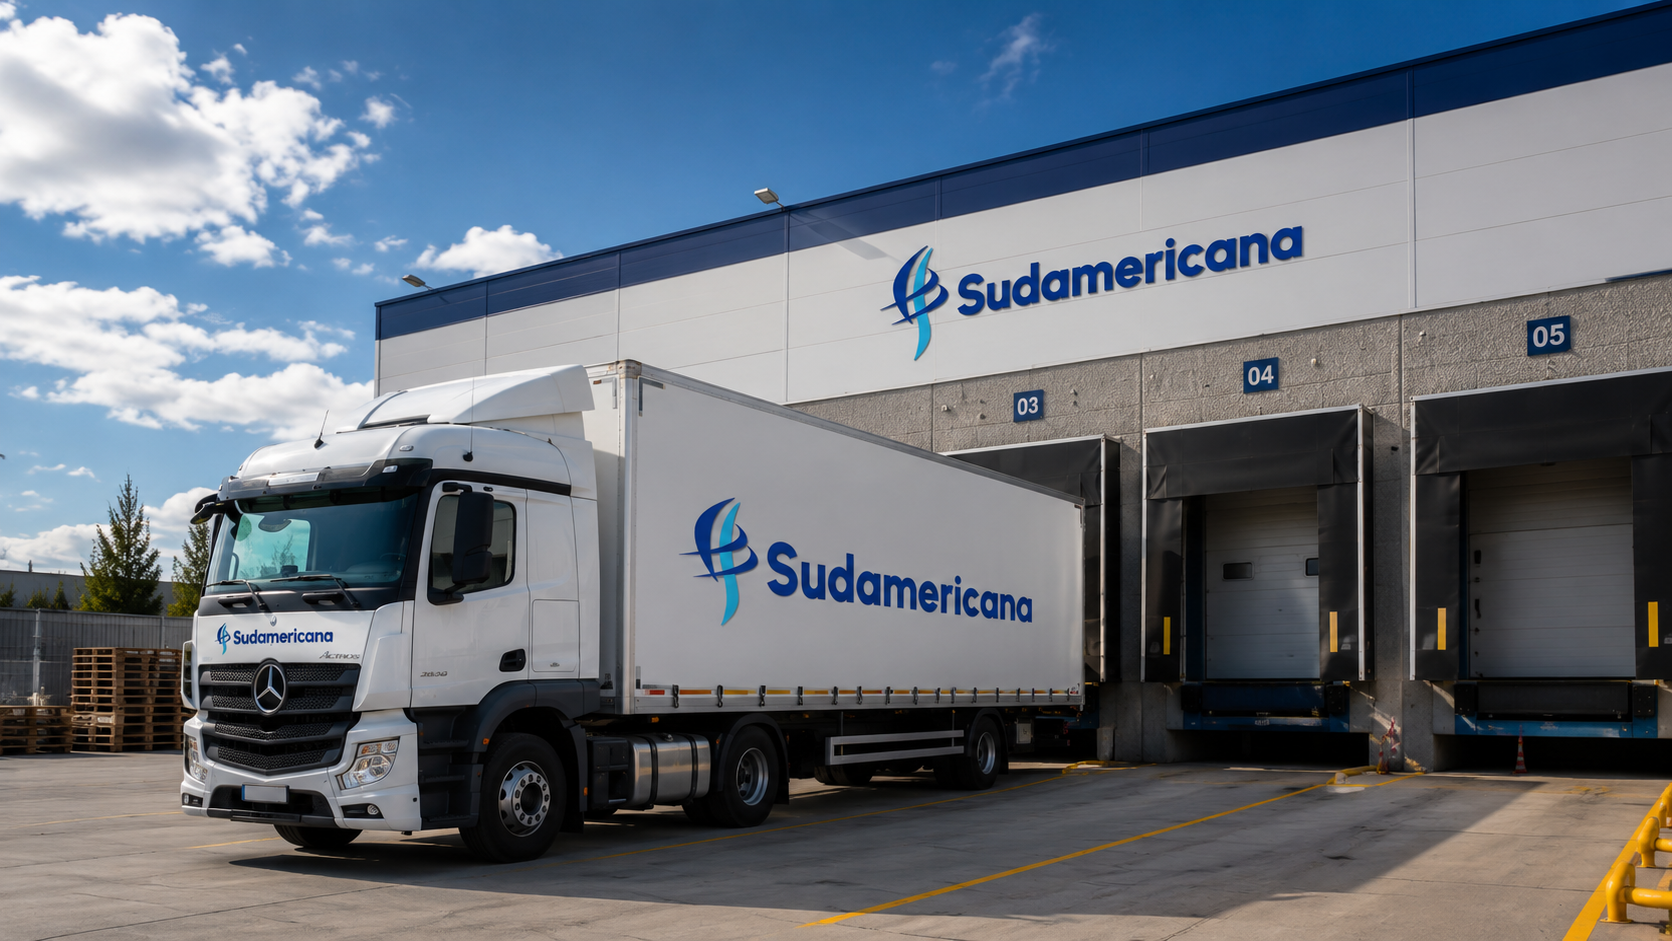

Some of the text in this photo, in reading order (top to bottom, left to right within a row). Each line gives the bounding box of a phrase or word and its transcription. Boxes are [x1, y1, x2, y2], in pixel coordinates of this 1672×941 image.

[957, 225, 1303, 316] Sudamericana
[1531, 323, 1565, 348] 05
[1248, 365, 1275, 386] 04
[1017, 396, 1038, 415] 03
[767, 541, 1033, 623] Sudamericana
[233, 628, 334, 645] Sudamericana
